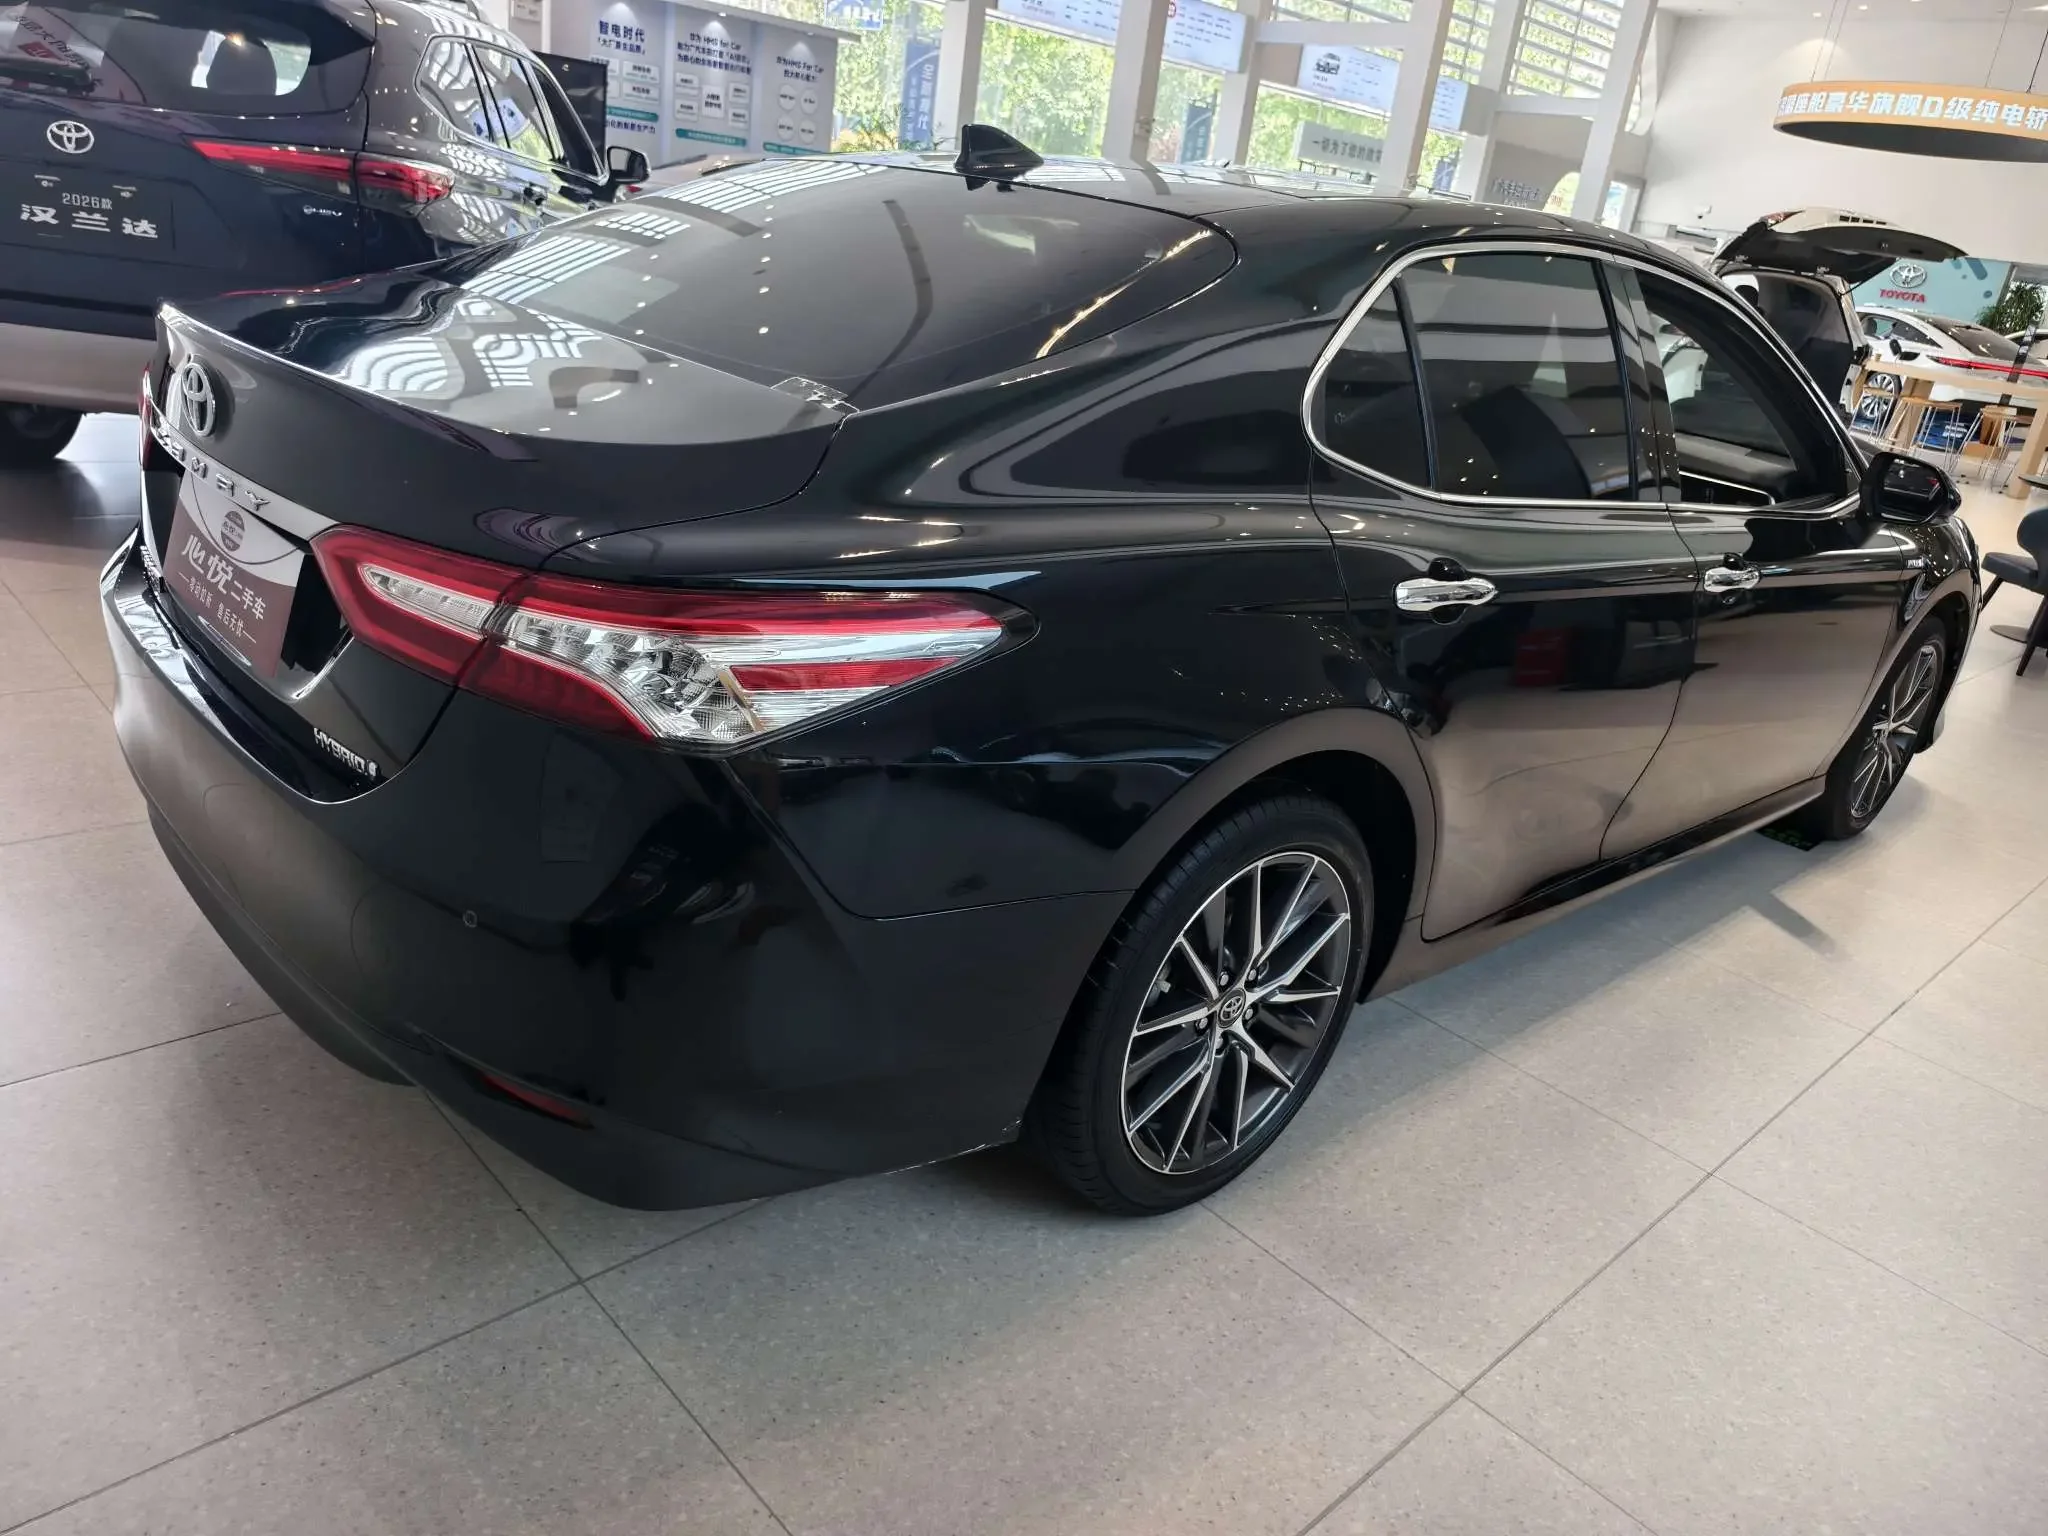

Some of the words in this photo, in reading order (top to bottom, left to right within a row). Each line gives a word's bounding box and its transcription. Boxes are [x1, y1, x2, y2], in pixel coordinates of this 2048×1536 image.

[62, 192, 113, 210] 2026款
[20, 204, 158, 239] 汉兰达
[1880, 289, 1925, 302] TOYOTA
[314, 728, 366, 774] HYBRID
